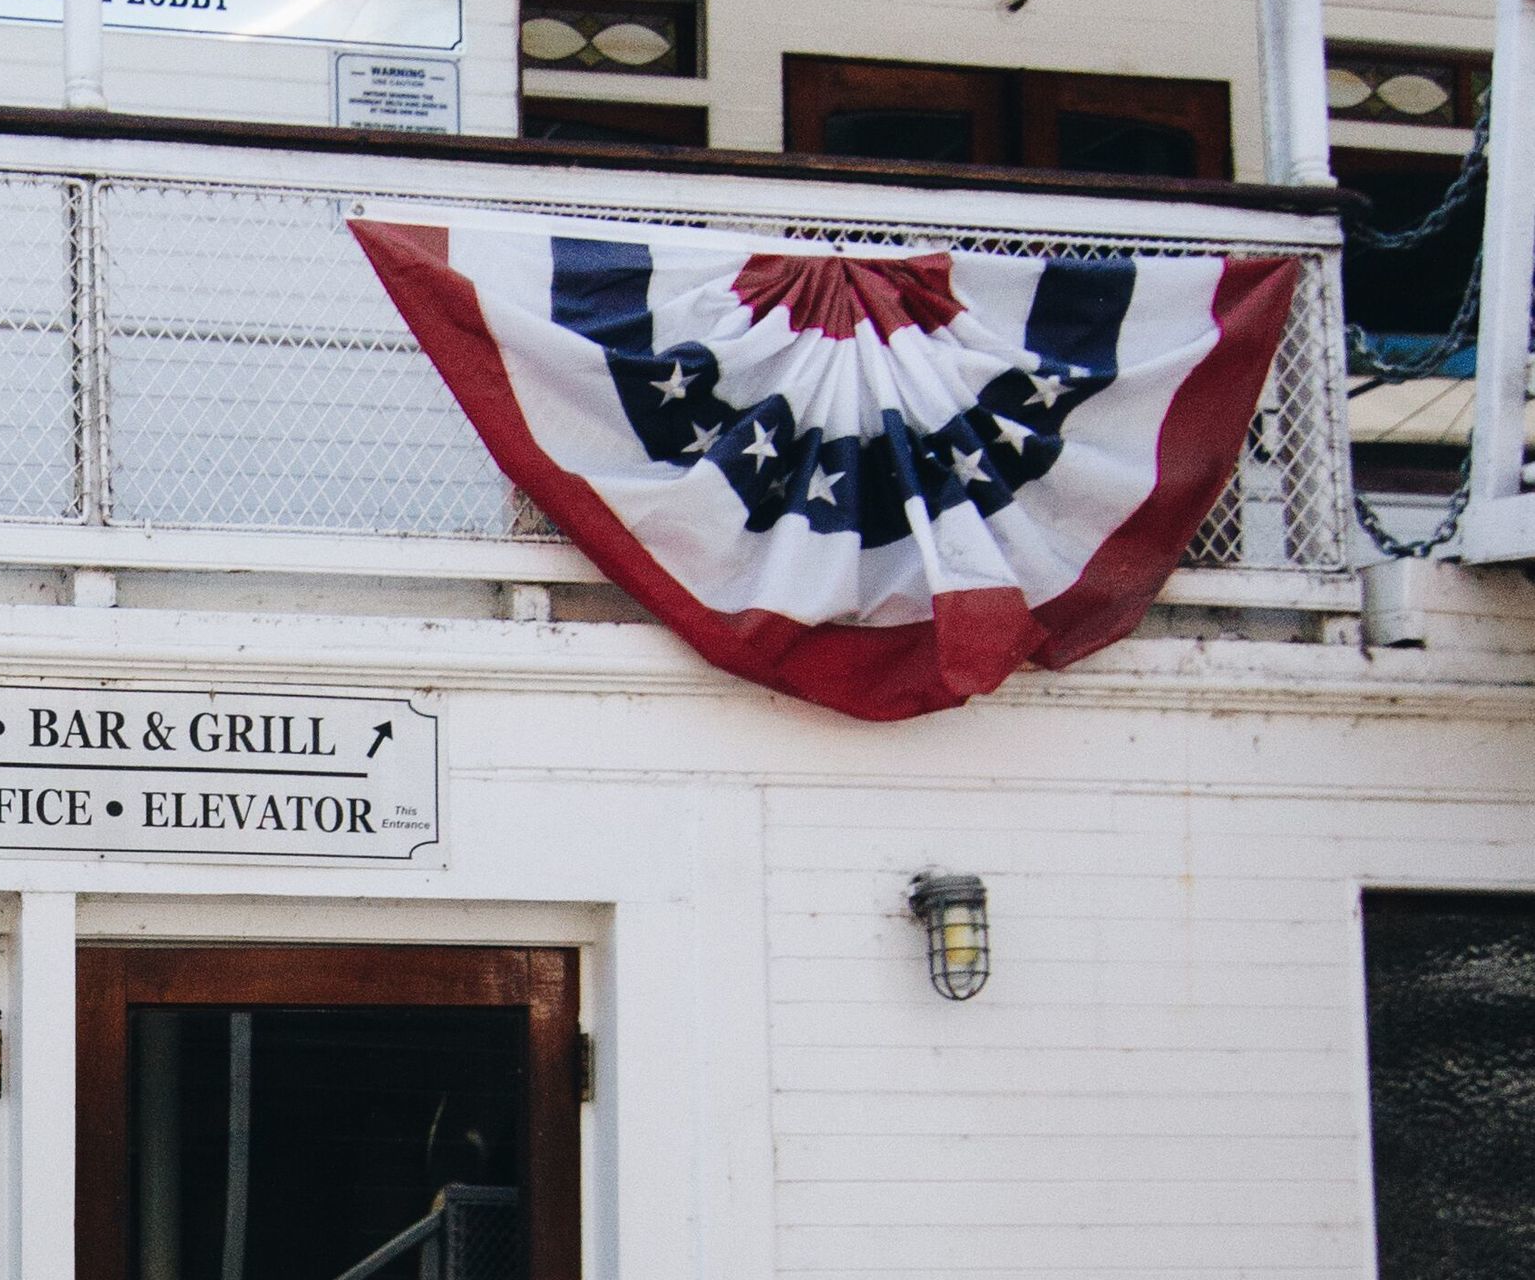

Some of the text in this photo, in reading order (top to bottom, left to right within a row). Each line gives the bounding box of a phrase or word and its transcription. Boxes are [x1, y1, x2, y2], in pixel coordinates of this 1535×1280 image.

[371, 67, 426, 79] WARNING
[29, 708, 131, 750] BAR
[142, 711, 176, 751] &
[189, 712, 336, 756] GRILL
[142, 791, 377, 834] ELEVATOR
[395, 806, 418, 816] This
[381, 819, 431, 830] Entrance
